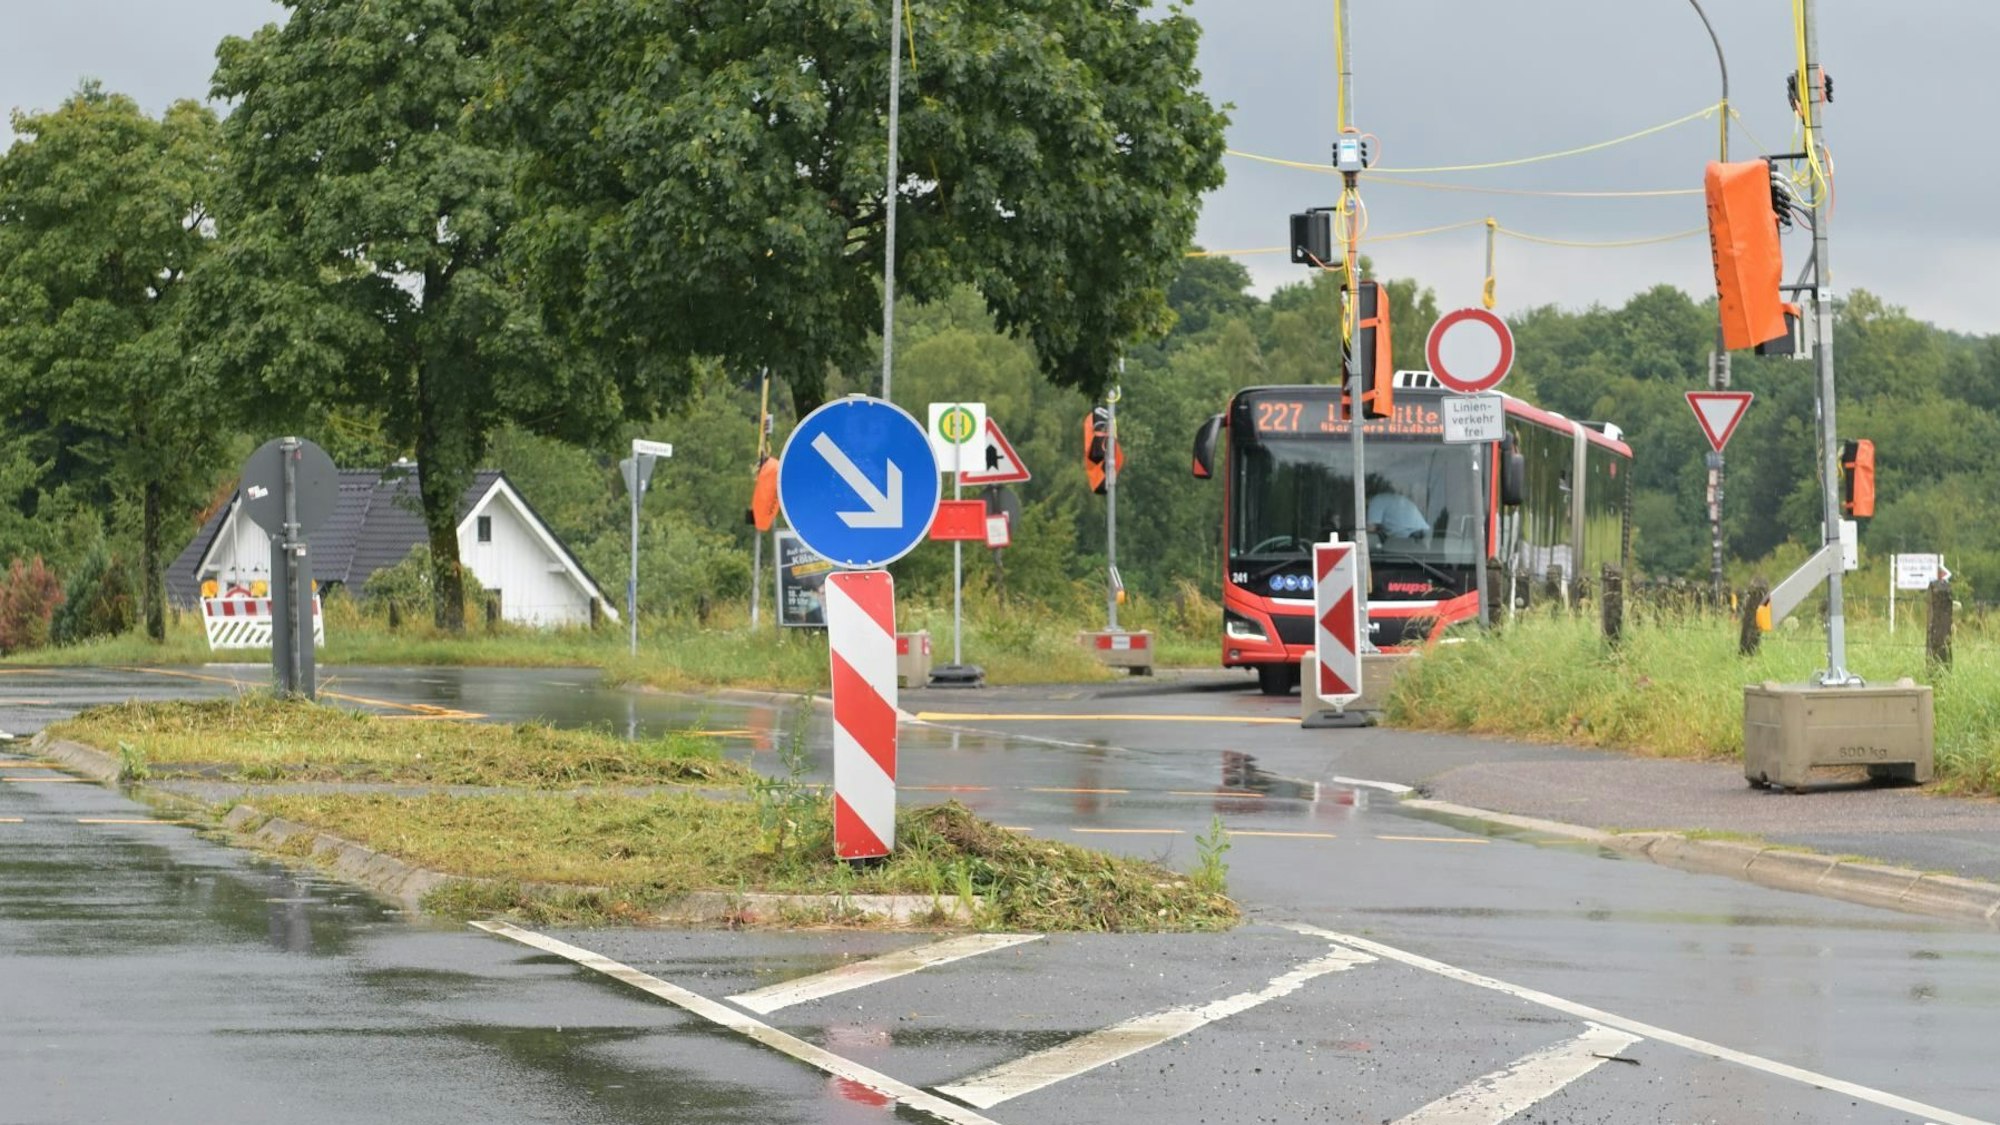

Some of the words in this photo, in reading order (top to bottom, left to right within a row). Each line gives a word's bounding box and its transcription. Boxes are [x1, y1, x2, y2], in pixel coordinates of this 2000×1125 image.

[1453, 402, 1492, 413] Linien-
[1258, 403, 1303, 432] 227
[1452, 413, 1494, 425] verkehr
[1464, 426, 1484, 438] frei
[1232, 572, 1248, 584] 241
[1388, 580, 1432, 594] wupsi
[1869, 746, 1888, 760] kg
